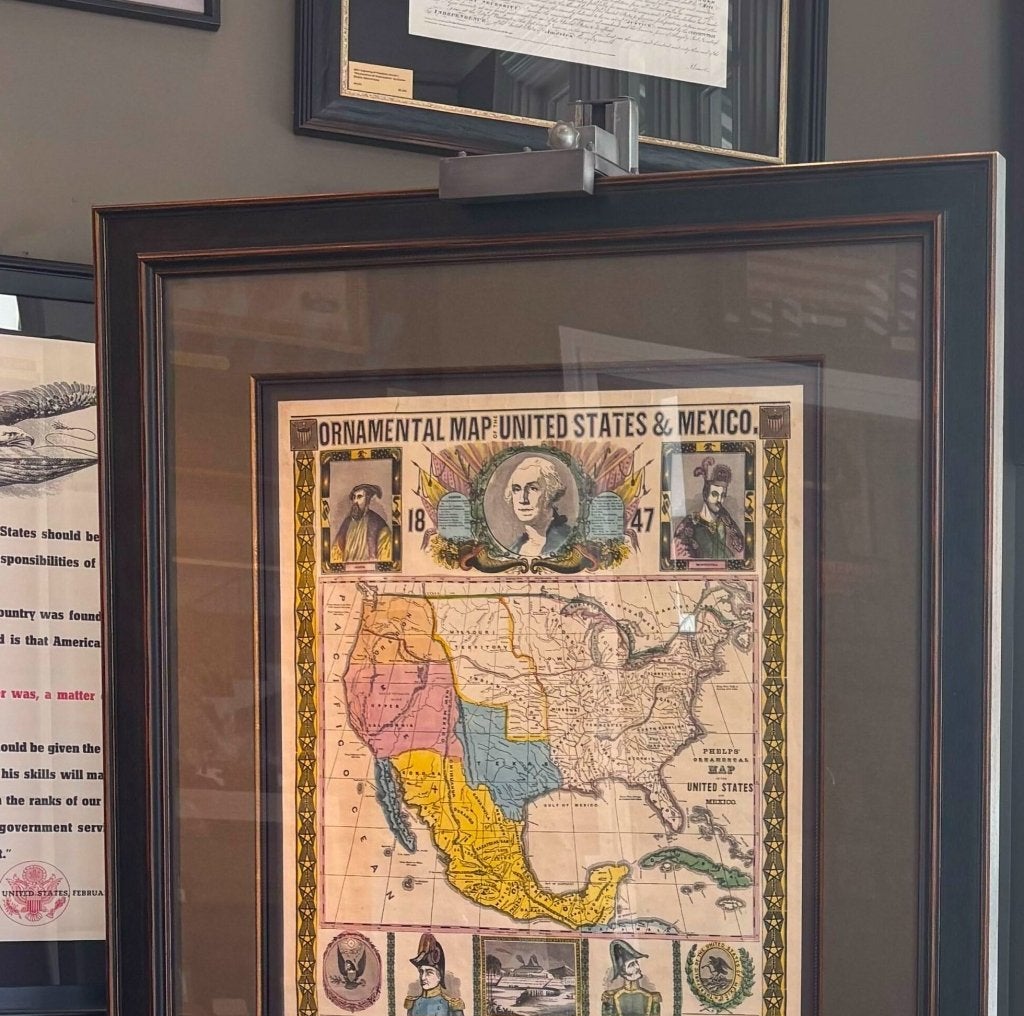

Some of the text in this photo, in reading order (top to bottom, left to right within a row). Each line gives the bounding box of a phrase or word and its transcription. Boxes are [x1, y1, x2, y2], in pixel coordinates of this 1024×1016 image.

[318, 416, 446, 448] ORNAMENTAL
[449, 414, 493, 442] MAP
[499, 412, 570, 441] UNITED
[573, 411, 649, 439] STATES
[653, 409, 674, 437] &
[677, 408, 760, 437] MEXICO.
[407, 508, 426, 534] 18
[630, 507, 656, 535] 47
[0, 525, 38, 540] States
[41, 528, 82, 542] should
[83, 557, 97, 569] of
[40, 610, 65, 621] was
[10, 634, 21, 646] is
[25, 634, 49, 647] that
[52, 636, 101, 649] America
[11, 689, 40, 702] was,
[44, 691, 53, 700] a
[56, 690, 96, 702] matter
[29, 742, 45, 753] be
[47, 743, 81, 755] given
[82, 743, 101, 754] the
[1, 768, 20, 780] his
[23, 768, 57, 780] skills
[60, 769, 84, 781] will
[707, 764, 737, 775] MAP
[686, 782, 754, 793] UNITED STATES
[6, 796, 102, 807] the ranks of our
[0, 823, 73, 835] government
[1, 890, 36, 898] UNITED
[36, 890, 71, 898] STATES,
